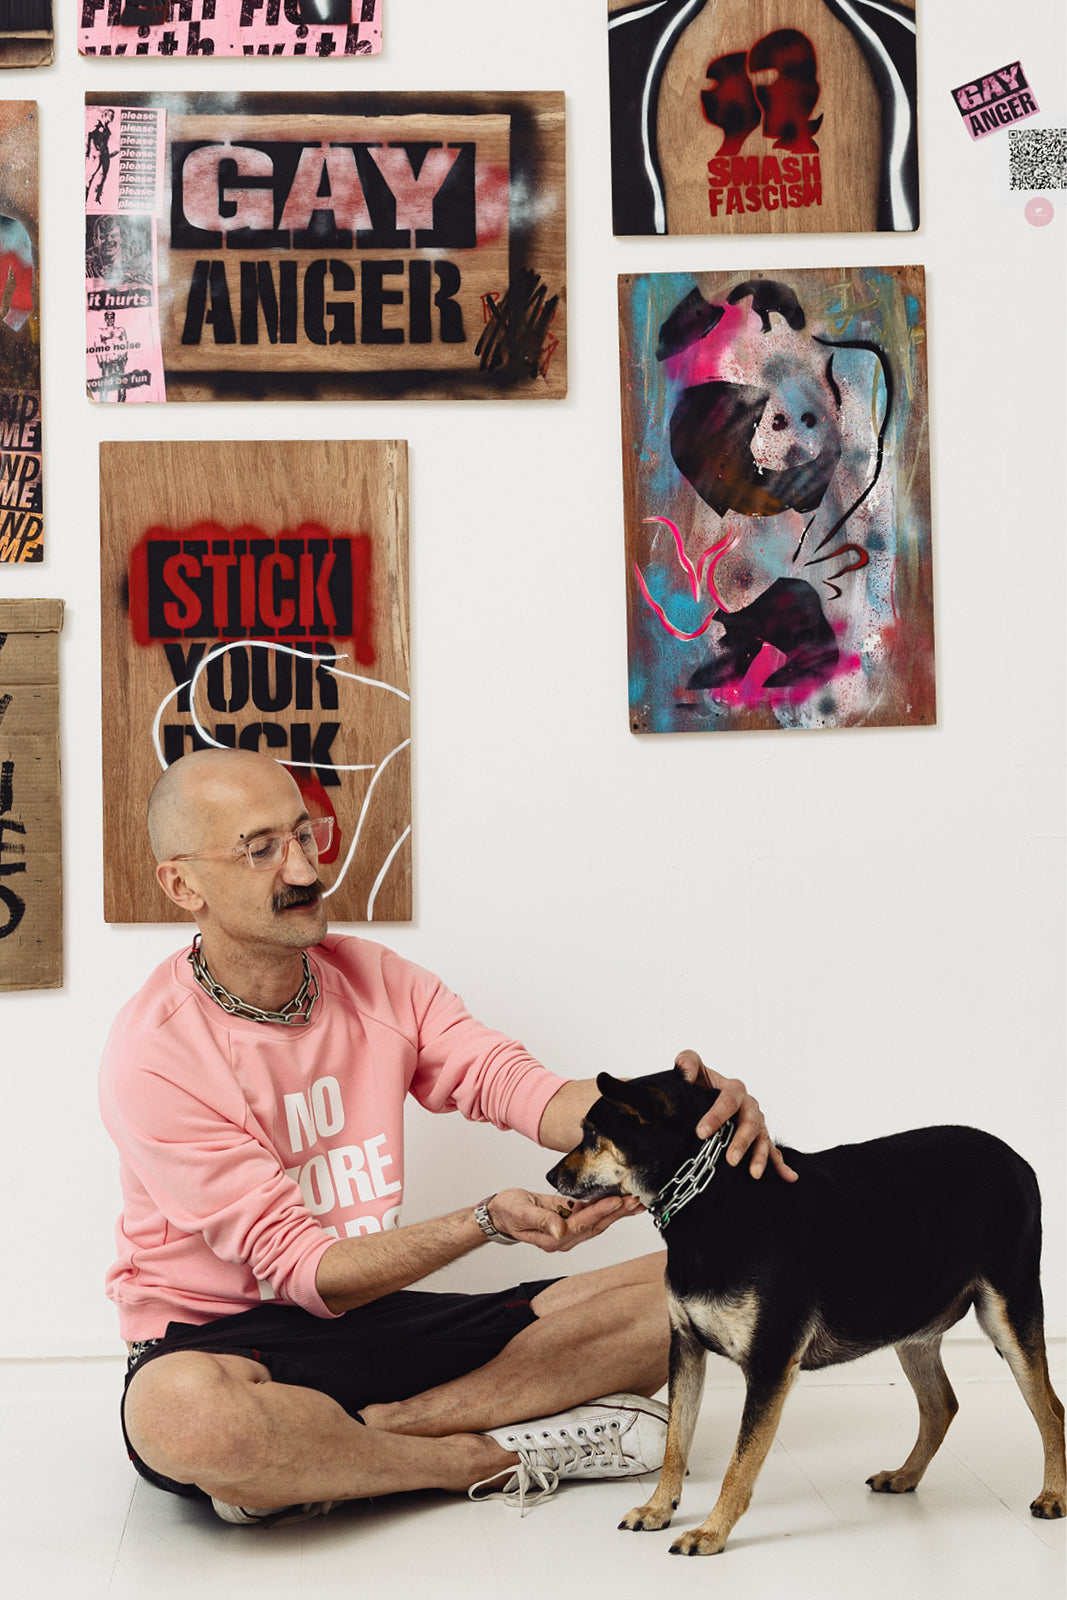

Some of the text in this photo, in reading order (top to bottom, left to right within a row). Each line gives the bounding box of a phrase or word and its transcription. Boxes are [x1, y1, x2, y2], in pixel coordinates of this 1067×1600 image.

[956, 65, 1020, 111] GAY
[969, 91, 1037, 138] ANGER
[182, 144, 461, 231] GAY
[707, 155, 821, 188] SMASH
[708, 182, 822, 217] FASCISM
[89, 293, 148, 307] it hurts
[181, 259, 467, 345] ANGER
[114, 341, 141, 351] noise
[131, 375, 148, 384] fun
[162, 552, 338, 630] STICK
[164, 641, 339, 713] YOUR
[283, 1075, 346, 1154] NO
[285, 1133, 403, 1217] ORE
